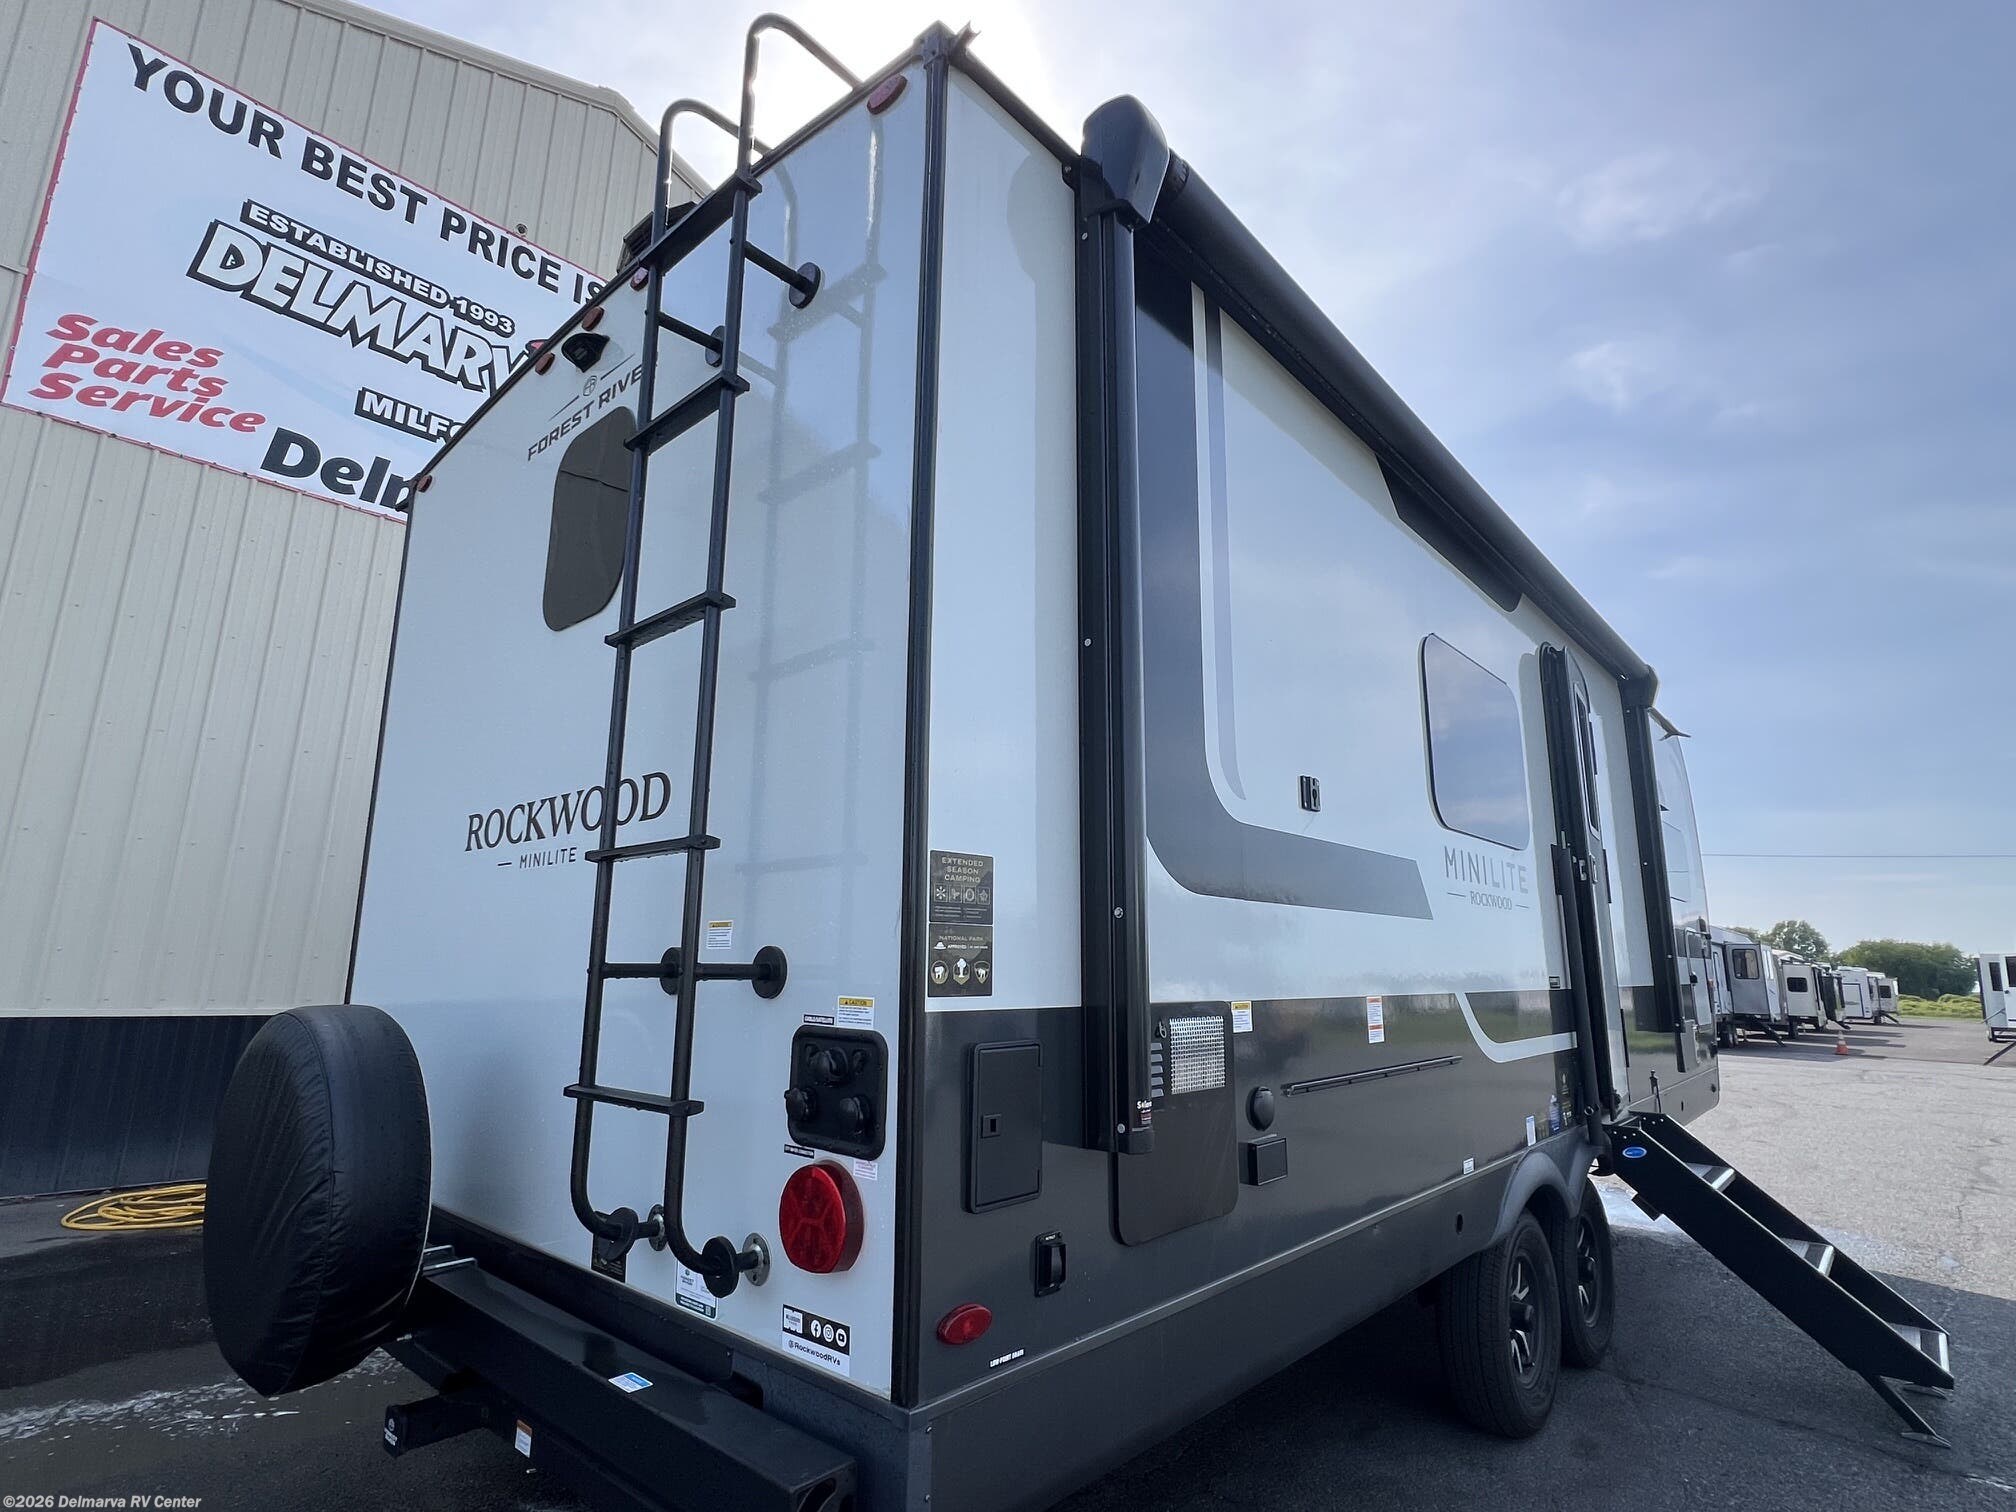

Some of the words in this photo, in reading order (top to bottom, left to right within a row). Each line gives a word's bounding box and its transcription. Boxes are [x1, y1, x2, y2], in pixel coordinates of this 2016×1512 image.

[127, 42, 285, 160] YOUR
[301, 136, 428, 225] BEST
[440, 207, 562, 294] PRICE
[247, 202, 449, 306] ESTABLISHED
[455, 297, 515, 336] 1993
[45, 313, 225, 368] Sales
[42, 342, 230, 397] Parts
[28, 372, 267, 432] Service
[527, 400, 595, 461] FOREST
[599, 363, 652, 409] RIVE
[465, 771, 671, 852] ROCKWOOD
[519, 847, 577, 869] MINILITE
[941, 857, 984, 867] EXTENDED
[944, 874, 981, 883] CAMPING
[946, 866, 979, 875] SEASON
[1444, 845, 1529, 895] MINILITE
[1470, 890, 1513, 910] ROCKWOOD
[788, 1340, 841, 1366] @RockwoodRVs
